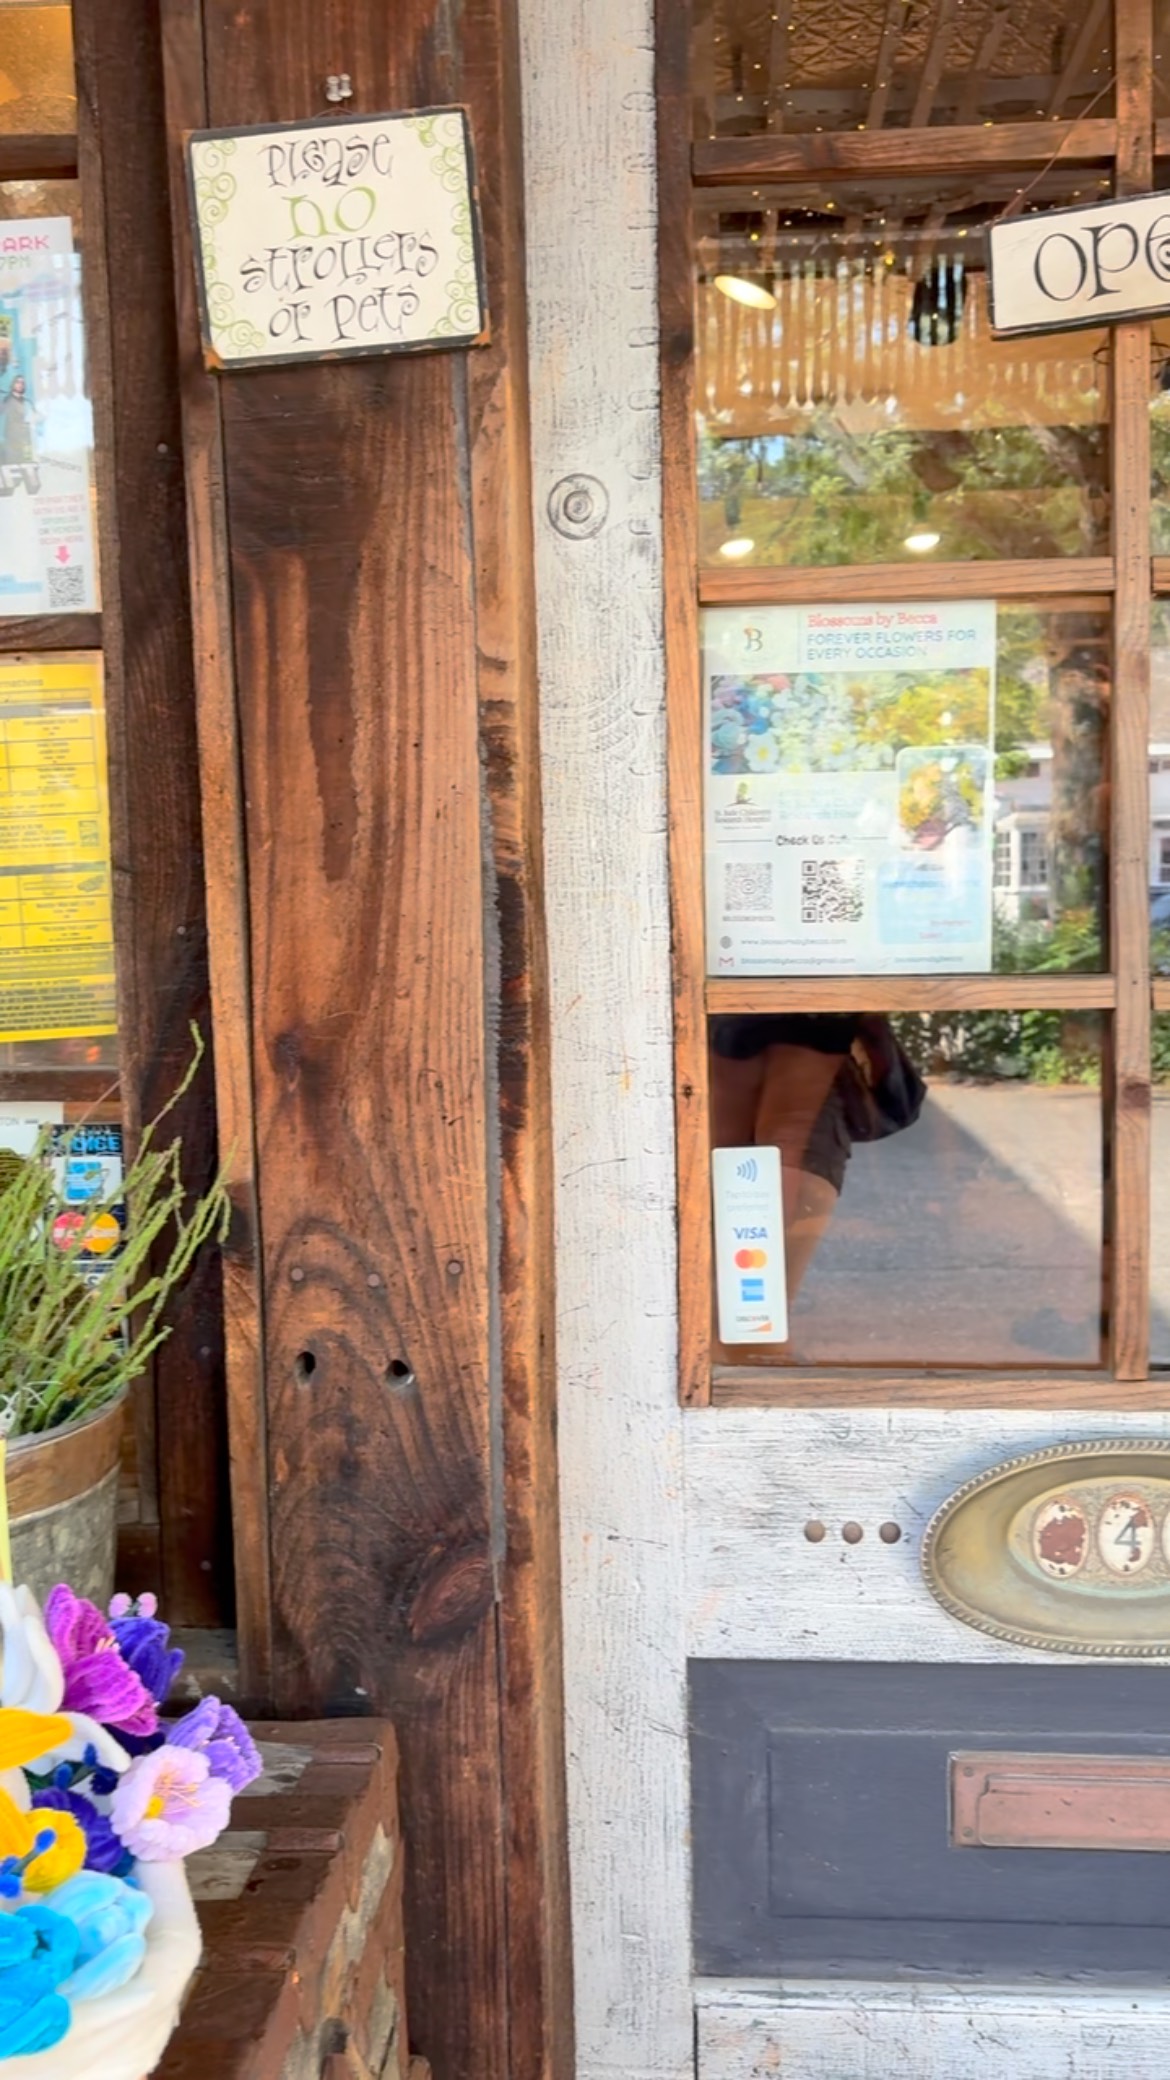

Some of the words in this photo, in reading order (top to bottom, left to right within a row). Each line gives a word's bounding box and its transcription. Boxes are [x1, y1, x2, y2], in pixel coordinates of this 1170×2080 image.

[281, 187, 377, 240] no
[3, 234, 50, 252] ARK
[239, 230, 439, 293] strollers
[269, 301, 313, 342] or
[807, 613, 873, 628] Blossoms
[876, 611, 894, 628] by
[896, 612, 938, 625] Becca
[807, 632, 872, 645] FOREVER
[876, 630, 943, 644] FLOWERS
[947, 629, 976, 641] FOR
[807, 647, 851, 660] EVERY
[855, 646, 928, 659] OCCASION
[776, 834, 808, 846] Check
[732, 1227, 768, 1239] VISA
[1112, 1509, 1142, 1557] 4
